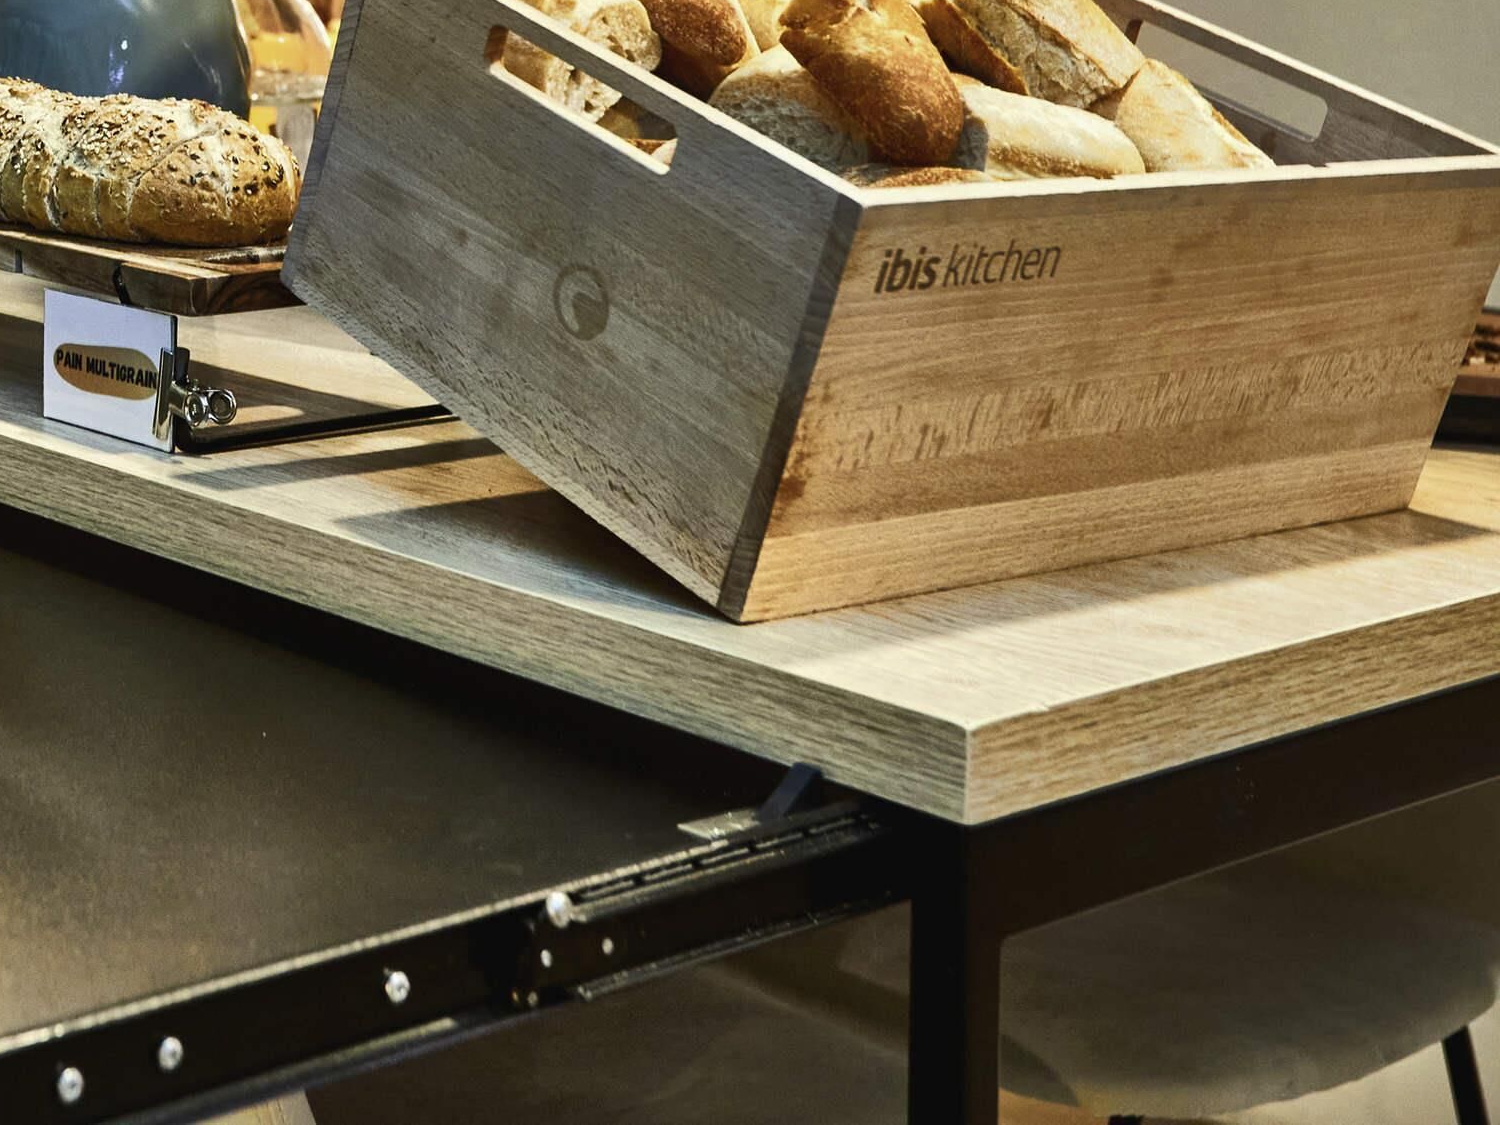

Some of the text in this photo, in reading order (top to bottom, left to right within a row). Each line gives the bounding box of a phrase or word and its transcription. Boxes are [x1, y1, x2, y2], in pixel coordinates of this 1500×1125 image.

[874, 238, 1061, 294] ibis kitchen
[56, 349, 158, 389] PAIN MULTIGRAIN
